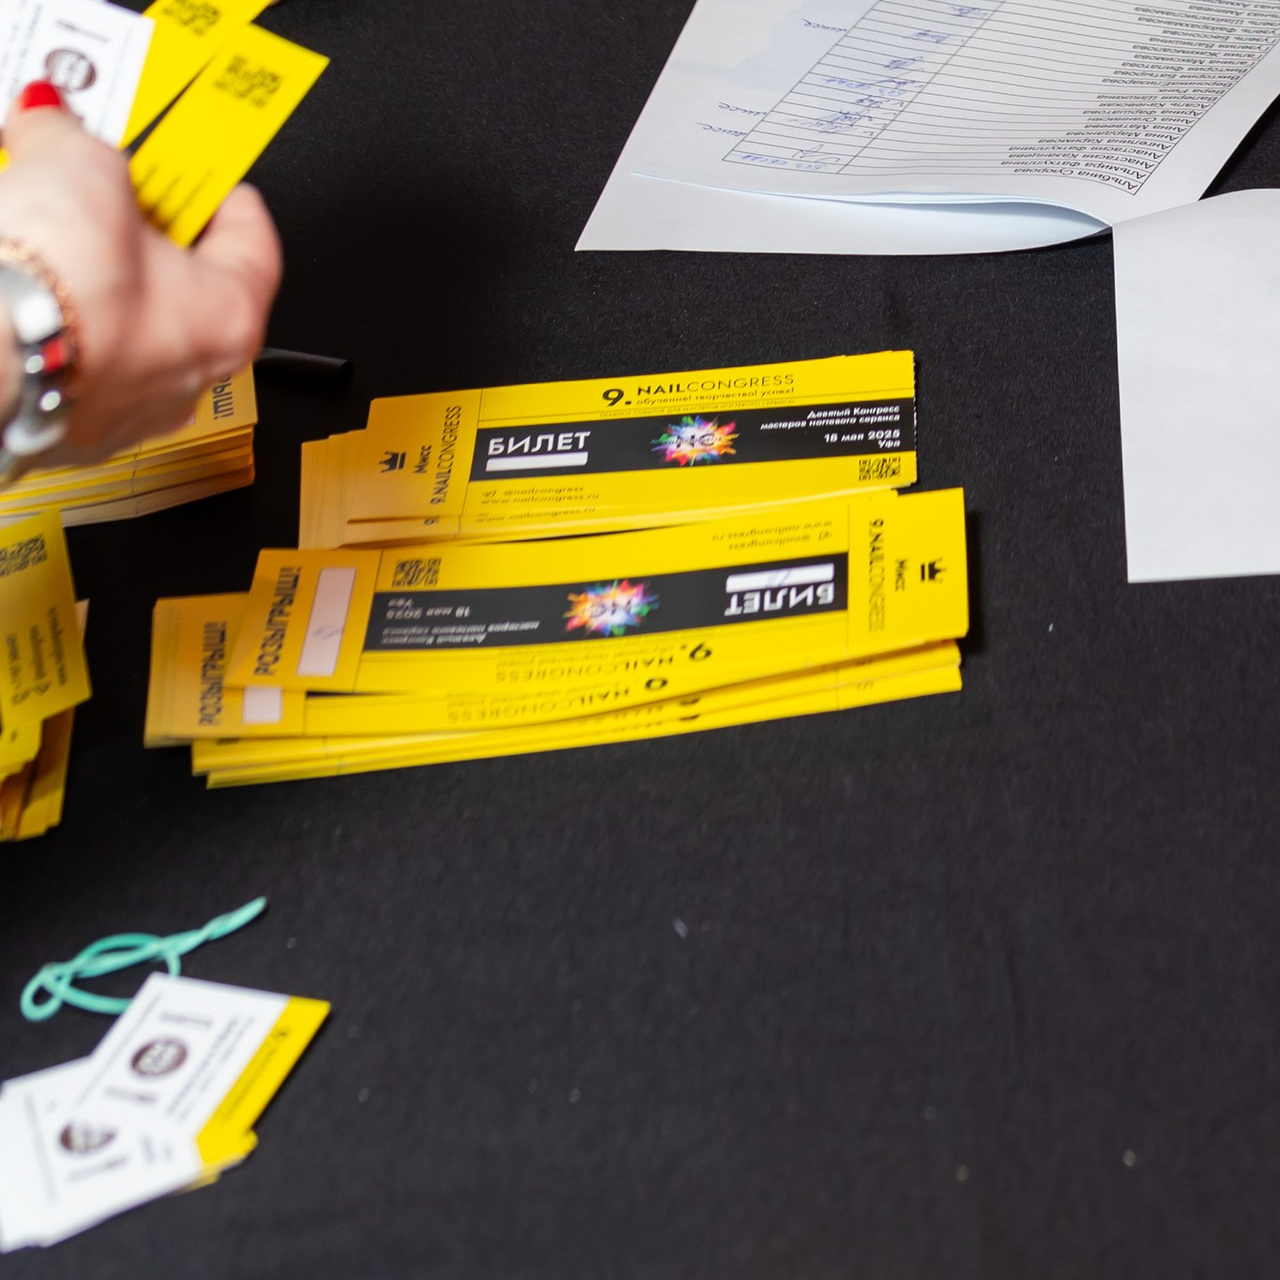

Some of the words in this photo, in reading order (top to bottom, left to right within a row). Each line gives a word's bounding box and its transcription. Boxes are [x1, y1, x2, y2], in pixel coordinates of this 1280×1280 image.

[1133, 53, 1205, 64] Максимова
[1159, 93, 1217, 102] Валерия
[1190, 87, 1225, 95] Вера
[1144, 132, 1178, 140] Анна
[1152, 124, 1186, 132] Анна
[1106, 137, 1171, 150] Ангелина
[1089, 144, 1163, 160] Анастасия
[1082, 154, 1153, 168] Анастасия
[1084, 162, 1146, 178] Альмира
[1077, 169, 1137, 191] Альбина
[637, 374, 794, 396] NAILCONGRESS
[637, 393, 692, 407] обучение!
[807, 408, 850, 420] Девятый
[853, 405, 900, 417] Конгресс
[760, 418, 806, 430] мастеров
[809, 416, 856, 428] ногтевого
[859, 413, 900, 425] сервиса
[488, 431, 591, 456] БИЛЕТ
[841, 432, 864, 442] мая
[868, 430, 900, 440] 2025
[878, 439, 900, 450] Уфа
[414, 445, 432, 474] Мисс
[430, 405, 462, 505] 9.NAILCONGRESS
[724, 582, 834, 616] БИЛЕТ
[254, 566, 302, 676] РОЗЫГРЫШ!
[199, 620, 227, 726] РОЗЫГРЫШ!
[496, 654, 673, 683] NAILCONGRESS
